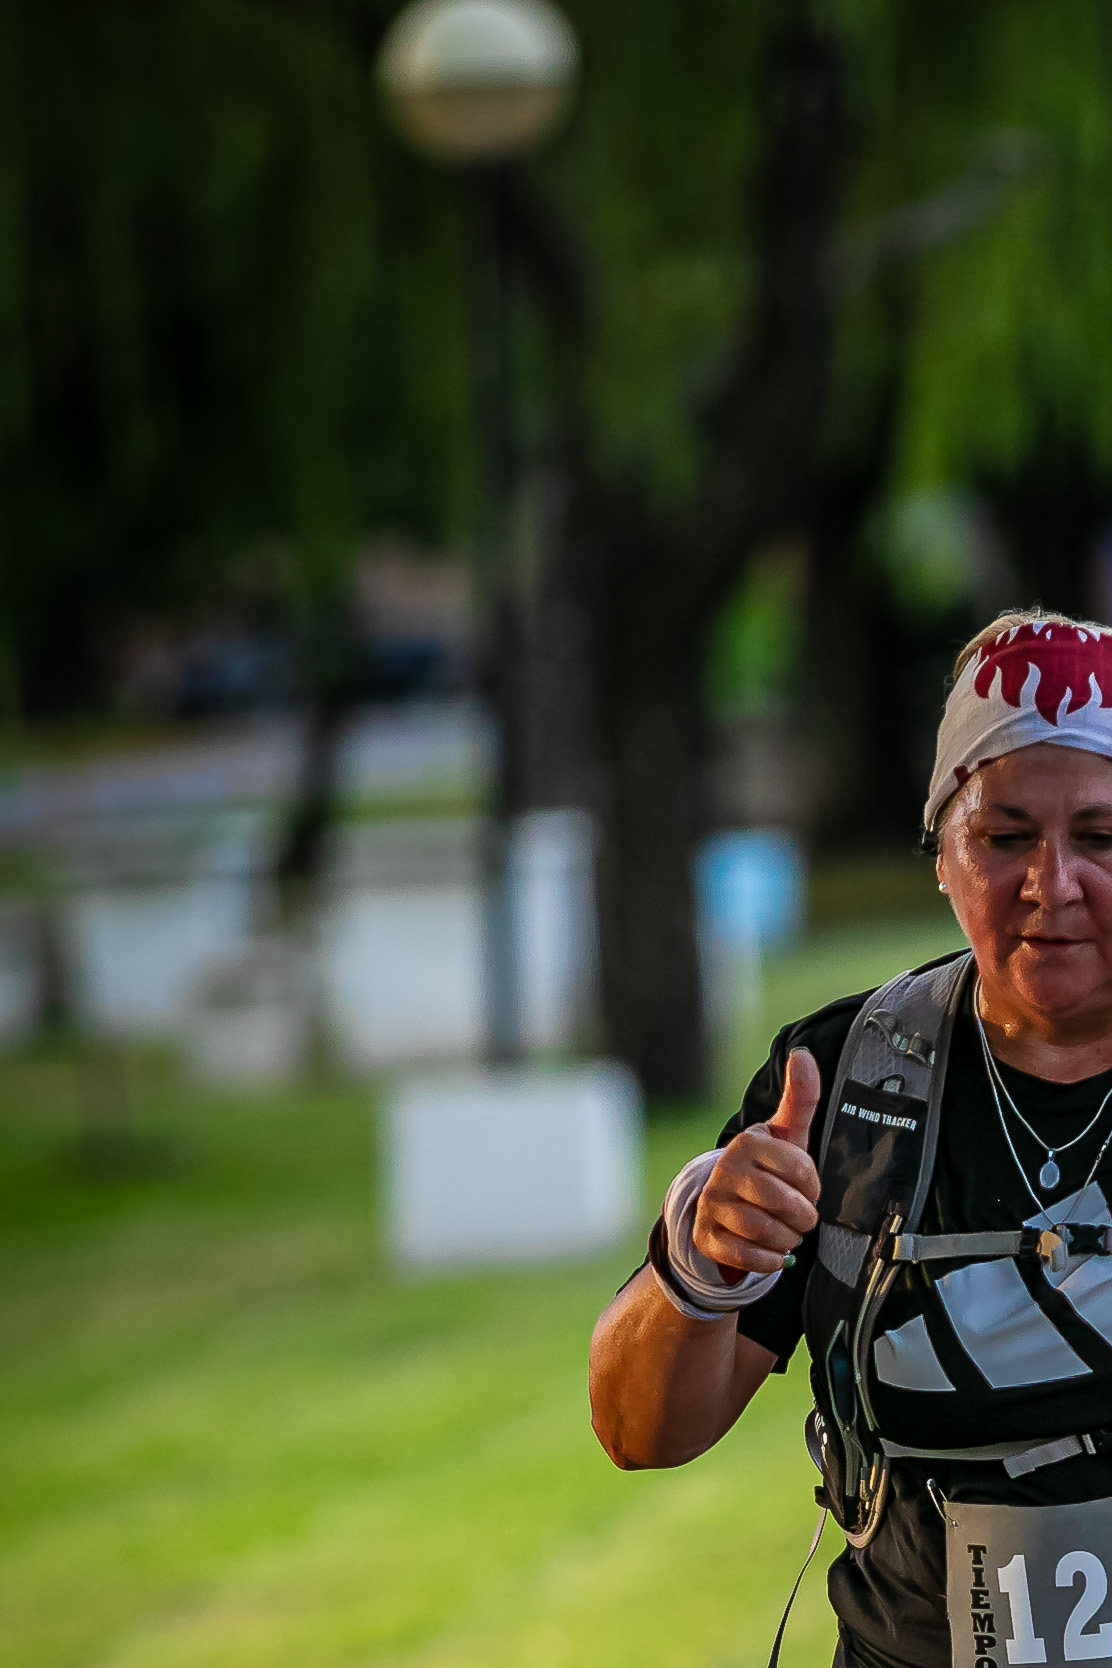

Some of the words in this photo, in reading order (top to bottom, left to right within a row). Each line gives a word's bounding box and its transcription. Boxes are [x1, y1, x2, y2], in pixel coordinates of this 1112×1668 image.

[841, 1102, 857, 1116] AIR
[858, 1107, 880, 1123] WIND
[882, 1113, 917, 1132] TRACKER
